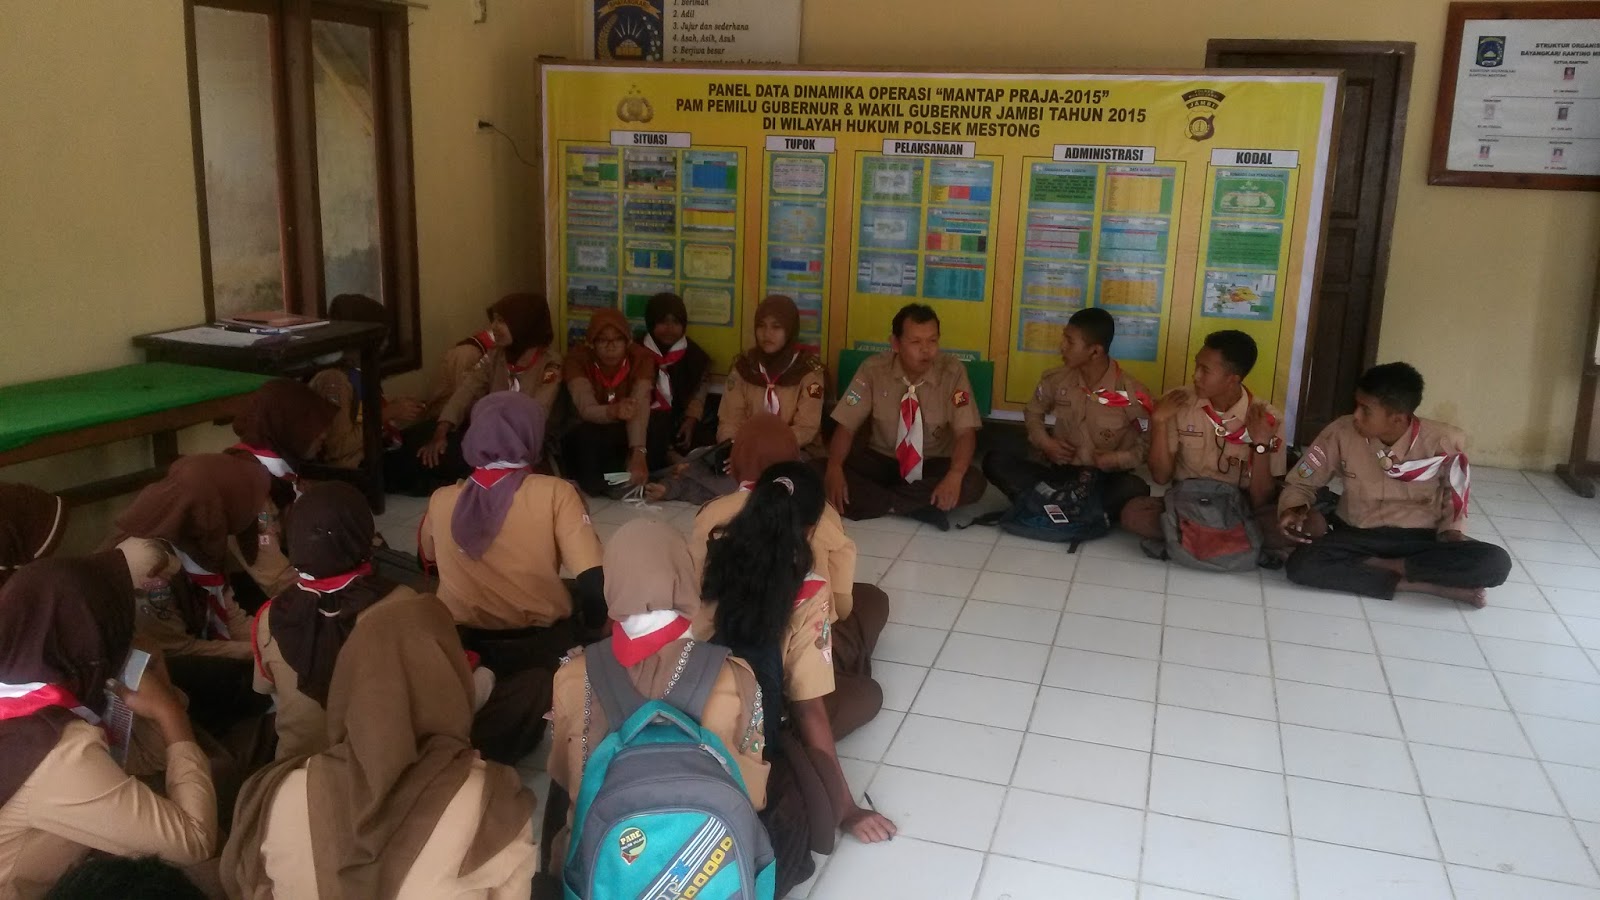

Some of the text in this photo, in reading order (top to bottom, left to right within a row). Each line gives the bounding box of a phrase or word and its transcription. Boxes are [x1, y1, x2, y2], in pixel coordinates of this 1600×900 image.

[672, 9, 695, 18] 2. Adil
[672, 21, 749, 32] 3. Jujur dan sederhana
[672, 34, 679, 42] 4.
[680, 34, 699, 43] Asah,
[718, 34, 736, 43] Asuh
[672, 45, 725, 56] 5. Berjiwa besar
[708, 83, 751, 97] PANEL
[755, 84, 790, 98] DATA
[794, 85, 865, 100] DINAMIKA
[868, 86, 932, 101] OPERASI
[676, 98, 1147, 123] PAM PEMILU GUBERNUR & WAKIL GUBERNUR JAMBI TAHUN 2015
[1189, 100, 1216, 108] JAMBI
[762, 116, 1041, 138] DI WILAYAH HUKUM POLSEK MESTONG
[633, 133, 668, 145] SITUASI
[784, 138, 816, 150] TUPOK
[894, 141, 964, 155] PELAKSANAAN
[1064, 147, 1144, 161] ADMINISTRASI
[1235, 151, 1273, 165] KODAL
[620, 830, 642, 845] PARE
